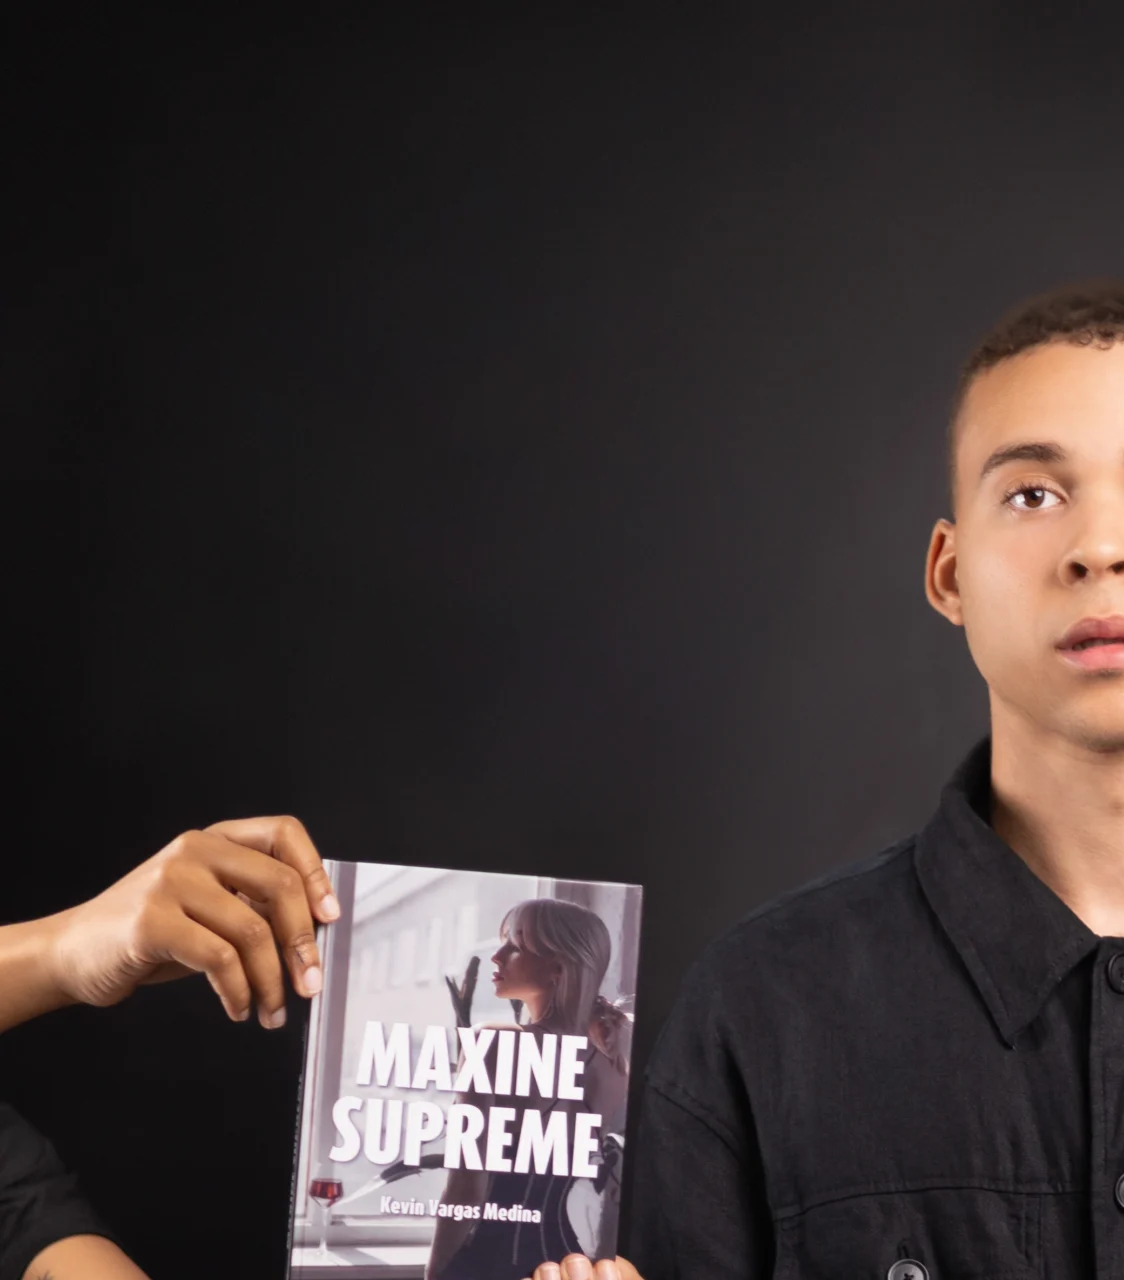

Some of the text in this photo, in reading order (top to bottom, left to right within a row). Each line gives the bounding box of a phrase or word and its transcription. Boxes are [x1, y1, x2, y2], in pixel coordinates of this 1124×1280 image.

[356, 1020, 588, 1101] MAXINE
[329, 1095, 602, 1178] SUPREME
[380, 1196, 542, 1223] Kevin Vargas Medina
